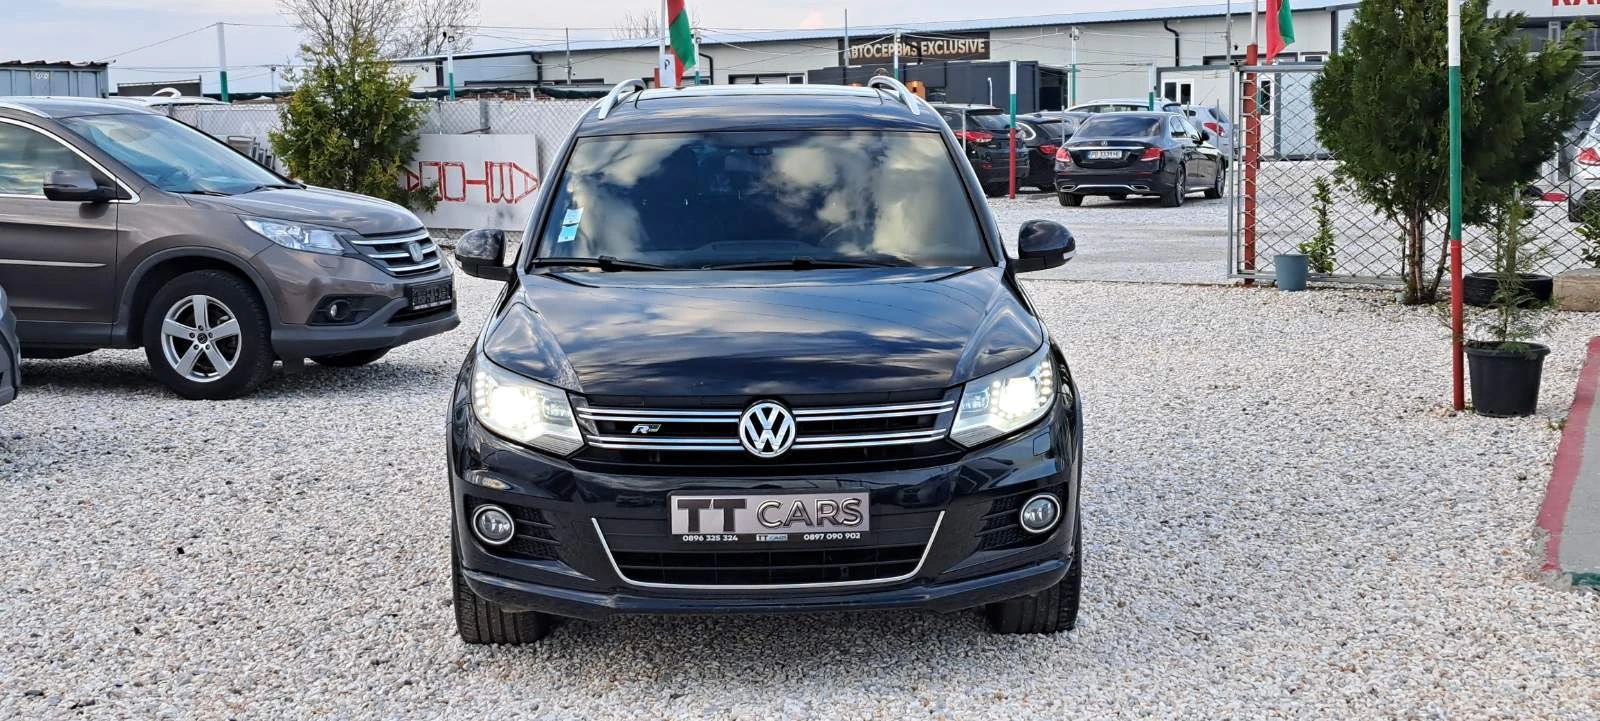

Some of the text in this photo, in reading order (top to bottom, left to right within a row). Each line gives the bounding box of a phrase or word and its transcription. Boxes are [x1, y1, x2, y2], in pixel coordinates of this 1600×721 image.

[921, 39, 985, 56] EXCLUSIVE
[742, 402, 794, 457] VW
[677, 497, 864, 532] TT CARS
[682, 534, 738, 542] 0896 325 324
[803, 532, 861, 541] 0897 090 902
